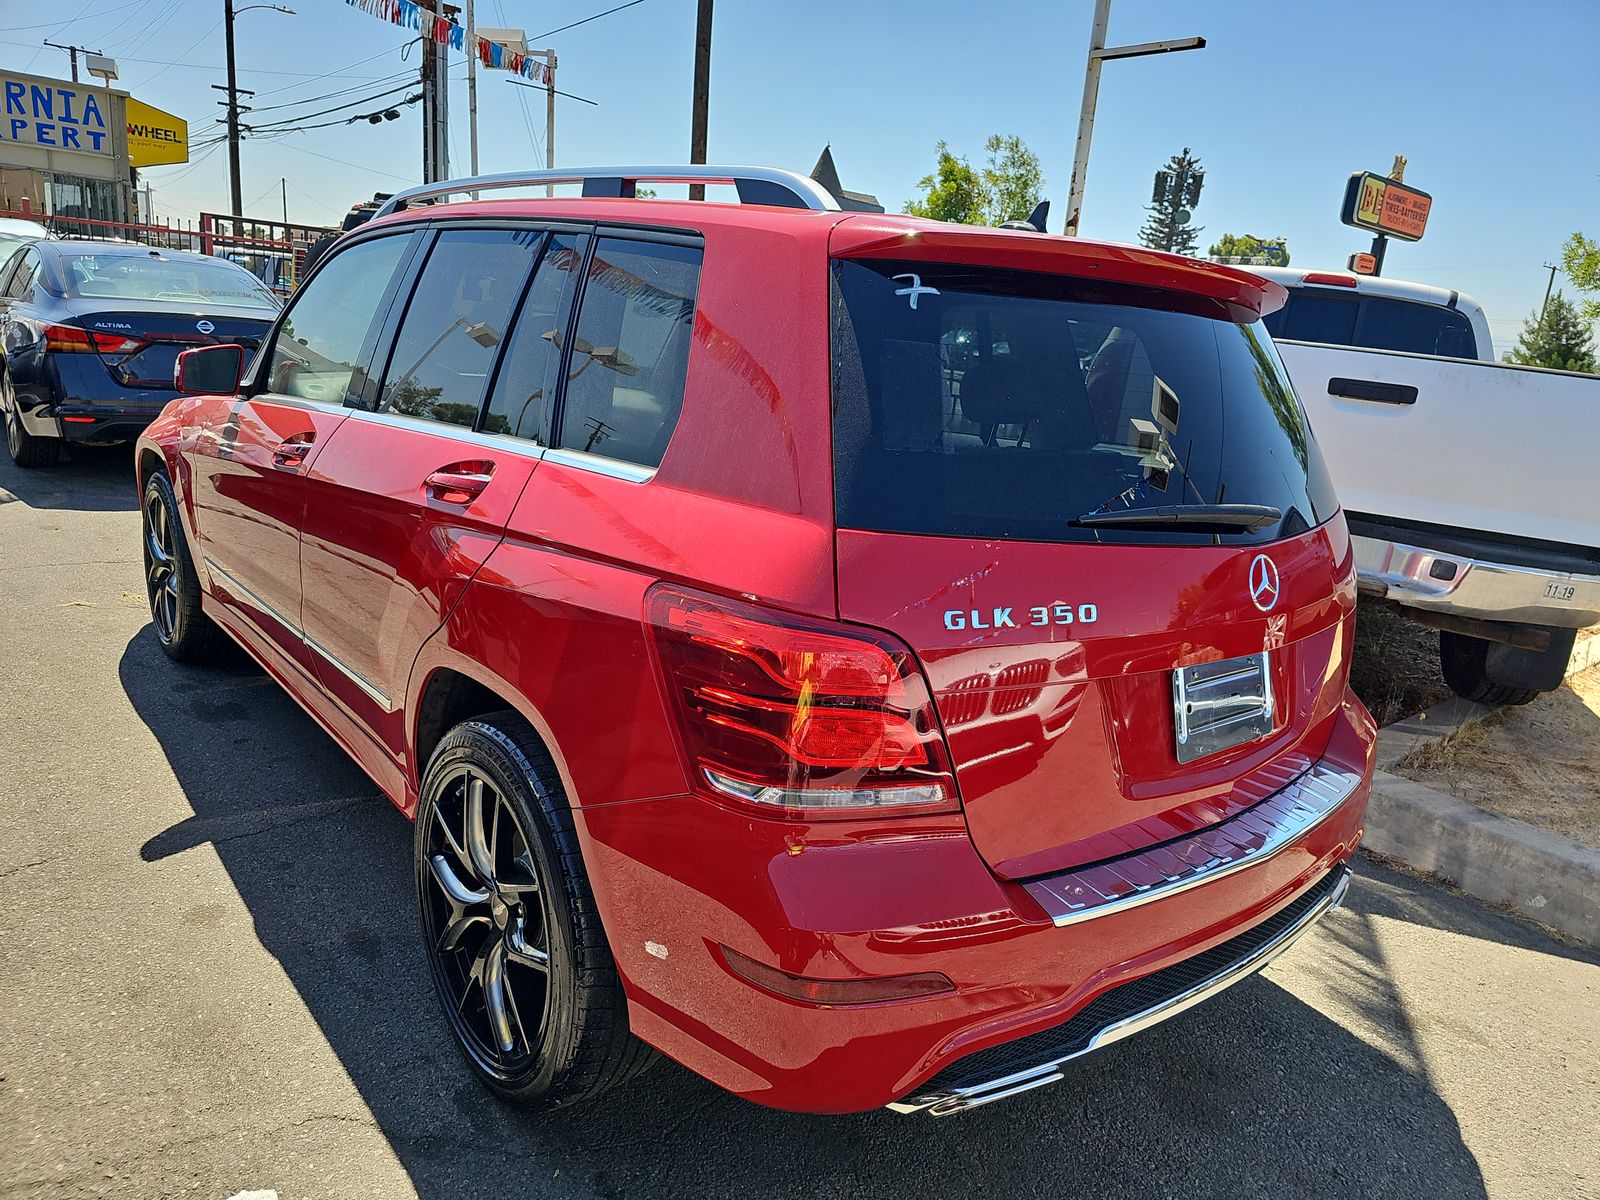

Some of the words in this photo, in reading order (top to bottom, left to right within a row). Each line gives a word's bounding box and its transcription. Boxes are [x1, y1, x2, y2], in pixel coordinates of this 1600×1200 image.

[0, 81, 105, 128] RNIA
[0, 118, 106, 151] PERT
[128, 123, 182, 144] WHEEL
[944, 607, 1015, 630] GLK
[1030, 603, 1098, 626] 350
